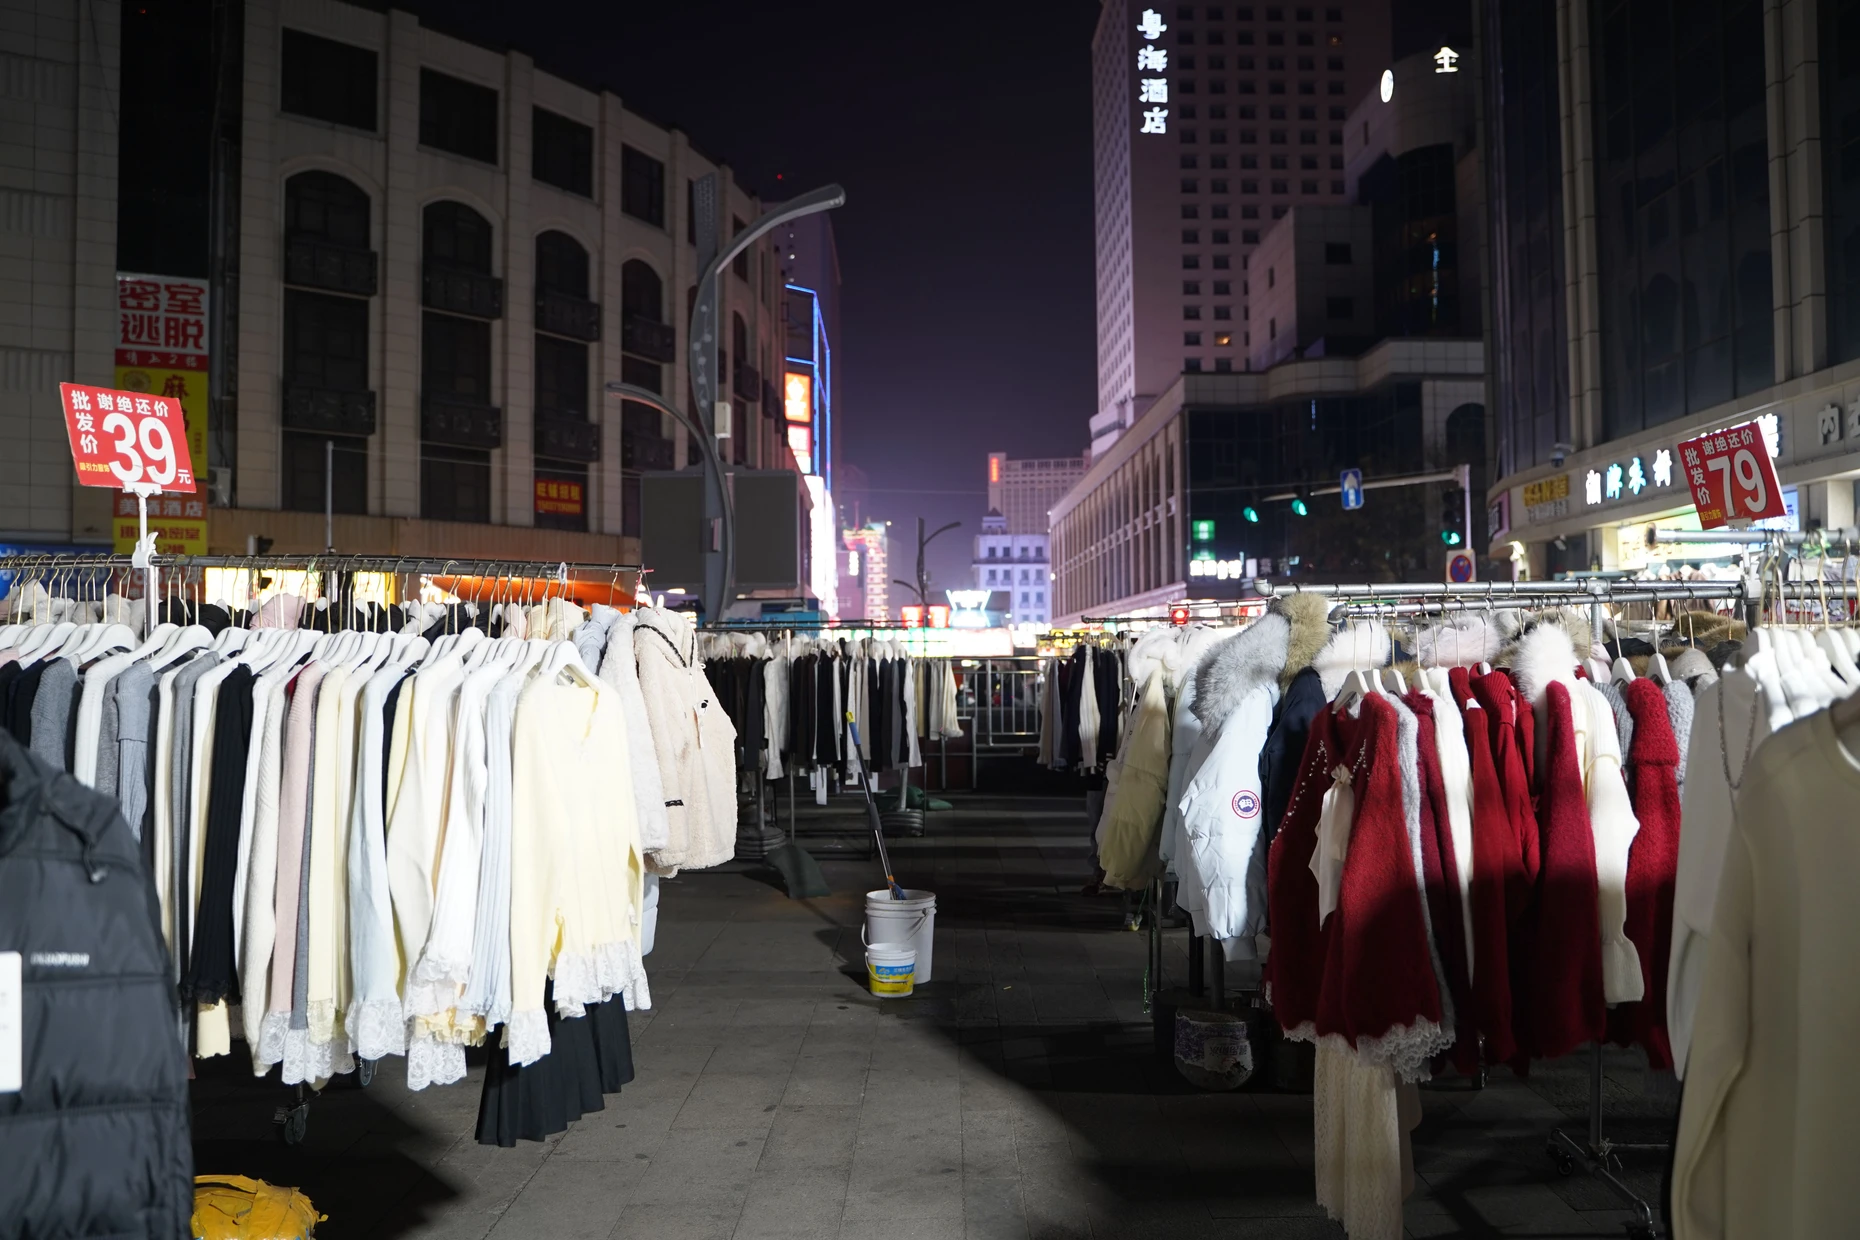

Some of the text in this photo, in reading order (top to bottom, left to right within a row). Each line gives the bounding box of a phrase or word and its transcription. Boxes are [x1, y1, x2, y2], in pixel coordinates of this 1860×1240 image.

[1136, 8, 1169, 135] 粤海酒店
[119, 280, 205, 316] 密室
[120, 313, 204, 350] 逃脱
[71, 390, 98, 454] 批发价
[96, 393, 168, 418] 谢绝还价
[102, 412, 177, 486] 39
[178, 468, 192, 485] 元
[1701, 428, 1755, 456] 谢绝还价
[1684, 447, 1712, 506] 批发价
[1706, 448, 1767, 518] 79
